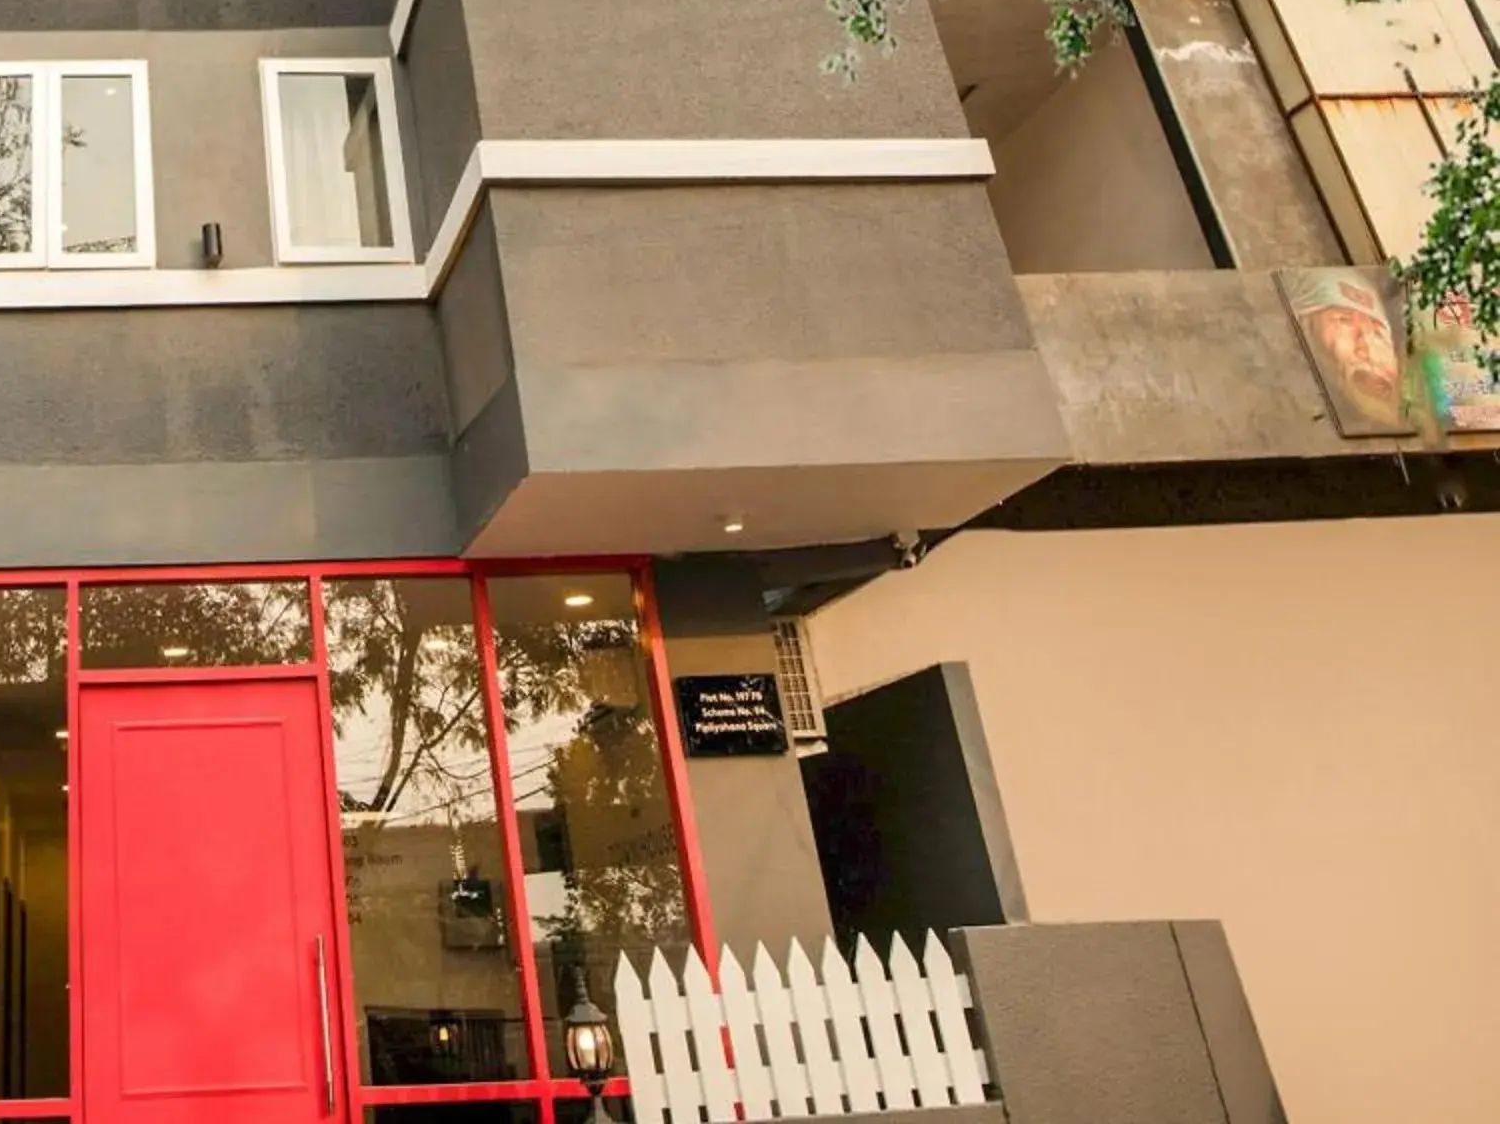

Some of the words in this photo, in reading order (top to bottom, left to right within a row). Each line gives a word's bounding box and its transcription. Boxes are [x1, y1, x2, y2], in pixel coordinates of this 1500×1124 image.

[699, 692, 718, 703] Plot
[719, 692, 735, 702] No.
[701, 707, 736, 717] Scheme
[737, 706, 752, 716] No.
[747, 721, 777, 733] Square
